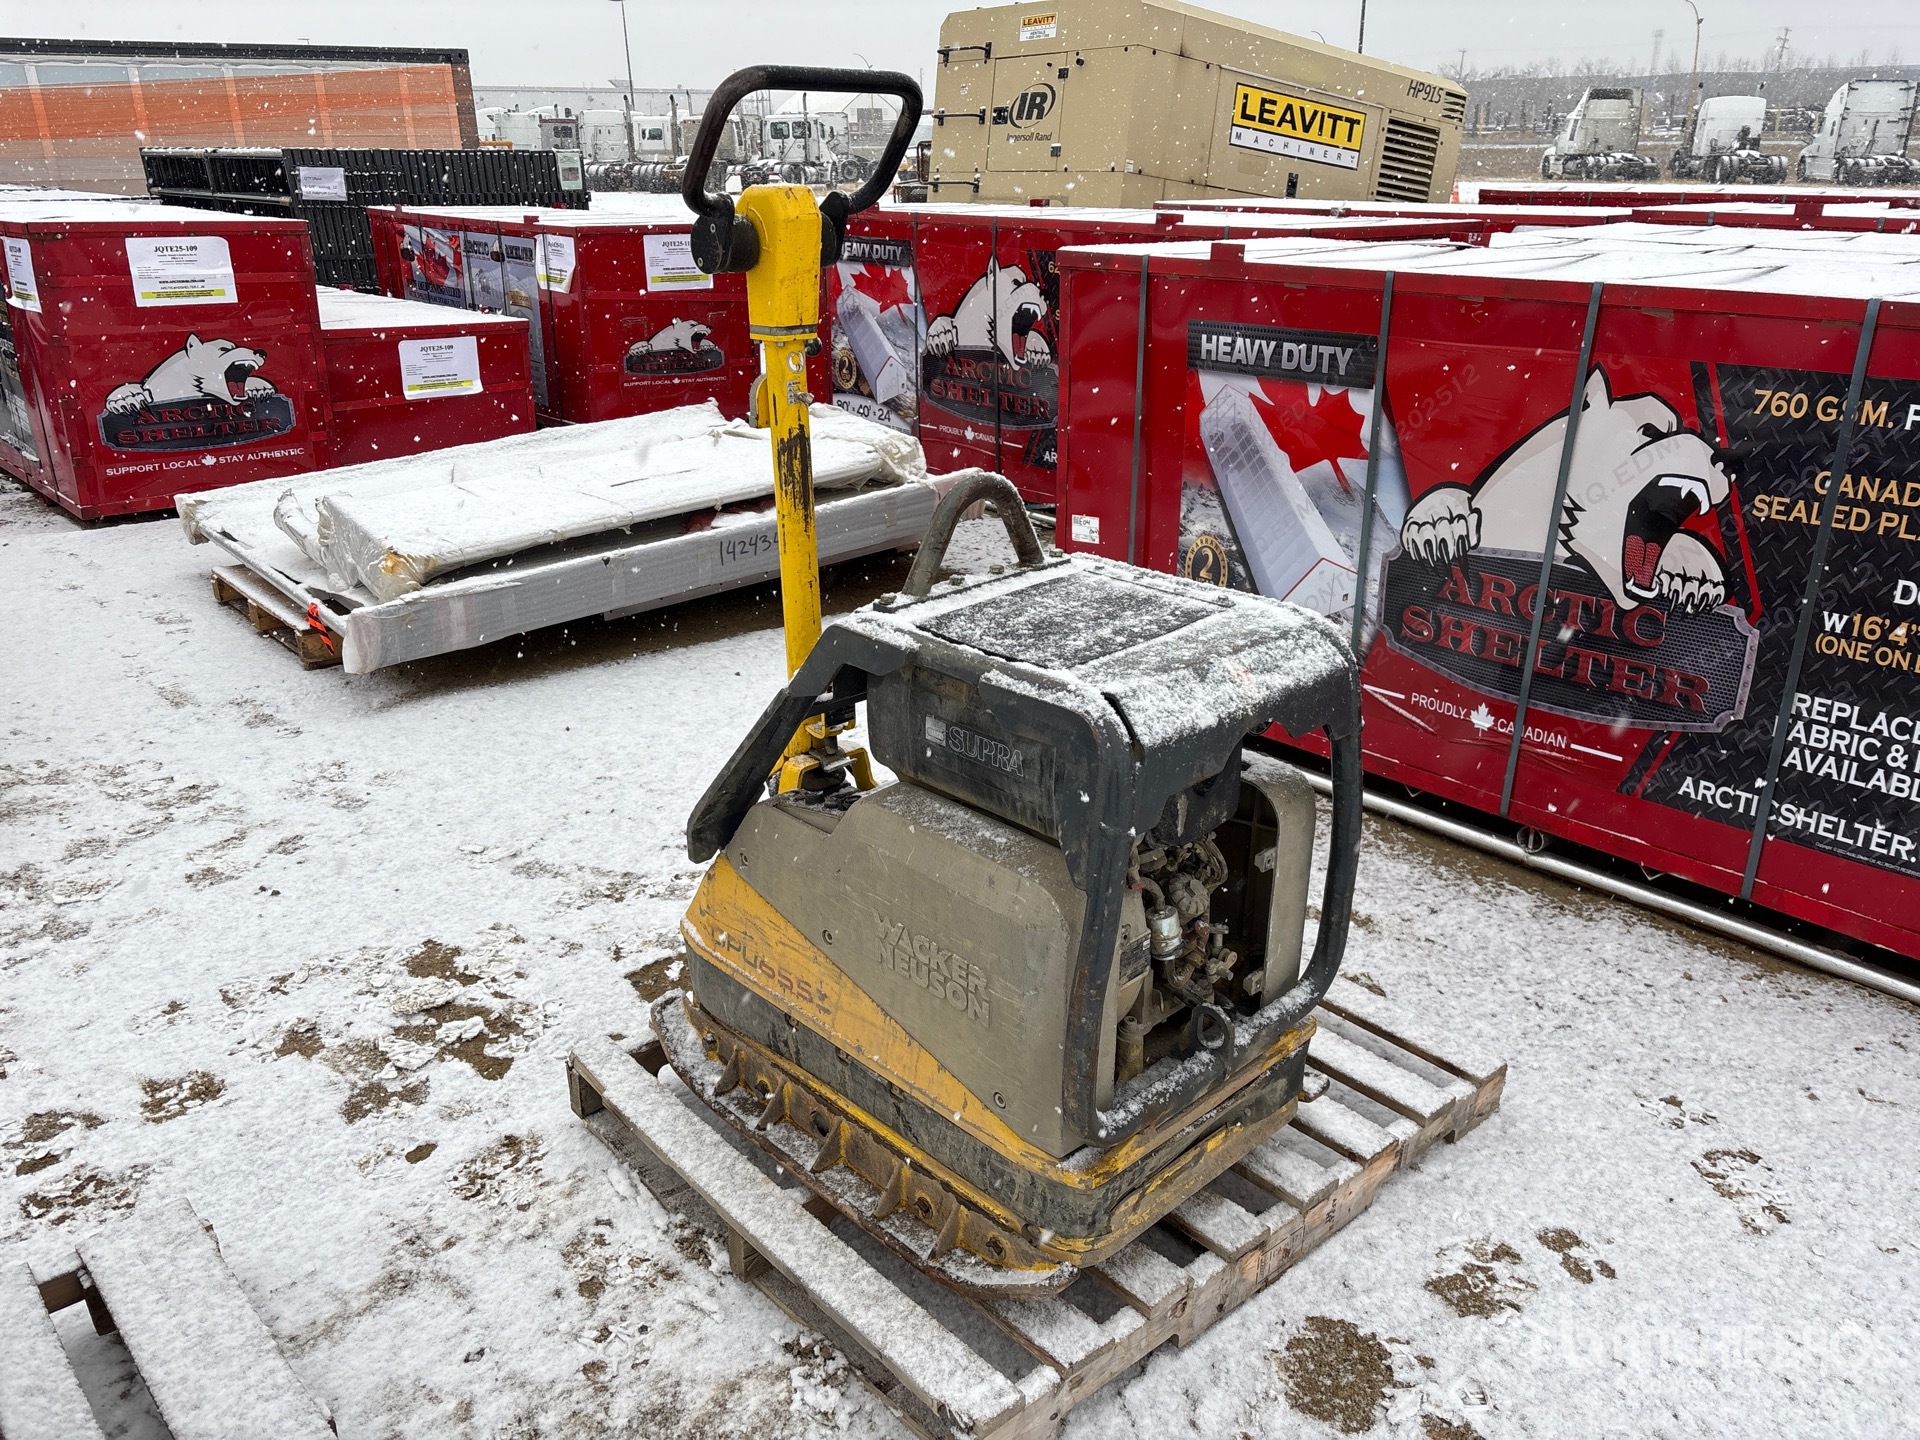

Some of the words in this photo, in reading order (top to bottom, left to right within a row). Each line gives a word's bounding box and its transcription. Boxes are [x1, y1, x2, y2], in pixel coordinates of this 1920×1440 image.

[1023, 16, 1055, 26] LEAVITT
[1015, 92, 1048, 120] IR
[1407, 79, 1444, 104] HP915
[1240, 93, 1361, 143] LEAVITT
[1034, 132, 1052, 141] Rand
[154, 245, 198, 253] JQTE25-109
[873, 244, 902, 261] DUTY
[420, 344, 454, 352] JQTE25-109
[1200, 333, 1277, 368] HEAVY
[1281, 342, 1353, 376] DUTY
[841, 356, 849, 373] 2
[944, 355, 1032, 388] ARCTIC
[134, 401, 257, 425] ARCTIC
[930, 378, 1050, 419] SHELTER
[1753, 388, 1809, 419] 760
[117, 416, 282, 444] SHELTER
[939, 425, 963, 436] PROUDLY
[106, 463, 160, 476] SUPPORT
[163, 459, 201, 470] LOCAL
[219, 454, 243, 464] STAY
[247, 447, 305, 461] AUTHENTIC
[1752, 494, 1871, 532] SEALED
[1877, 511, 1920, 542] PL
[1190, 538, 1225, 562] WARRANTY
[1199, 547, 1213, 579] 2
[1437, 566, 1667, 648] ARCTIC
[1401, 604, 1710, 715] SHELTER
[1815, 633, 1873, 663] (ONE
[1411, 692, 1467, 721] PROUDLY
[949, 725, 1024, 777] SUPRA
[1886, 744, 1909, 770] &
[872, 908, 991, 1003] WACKER
[876, 937, 990, 1028] NEUSON
